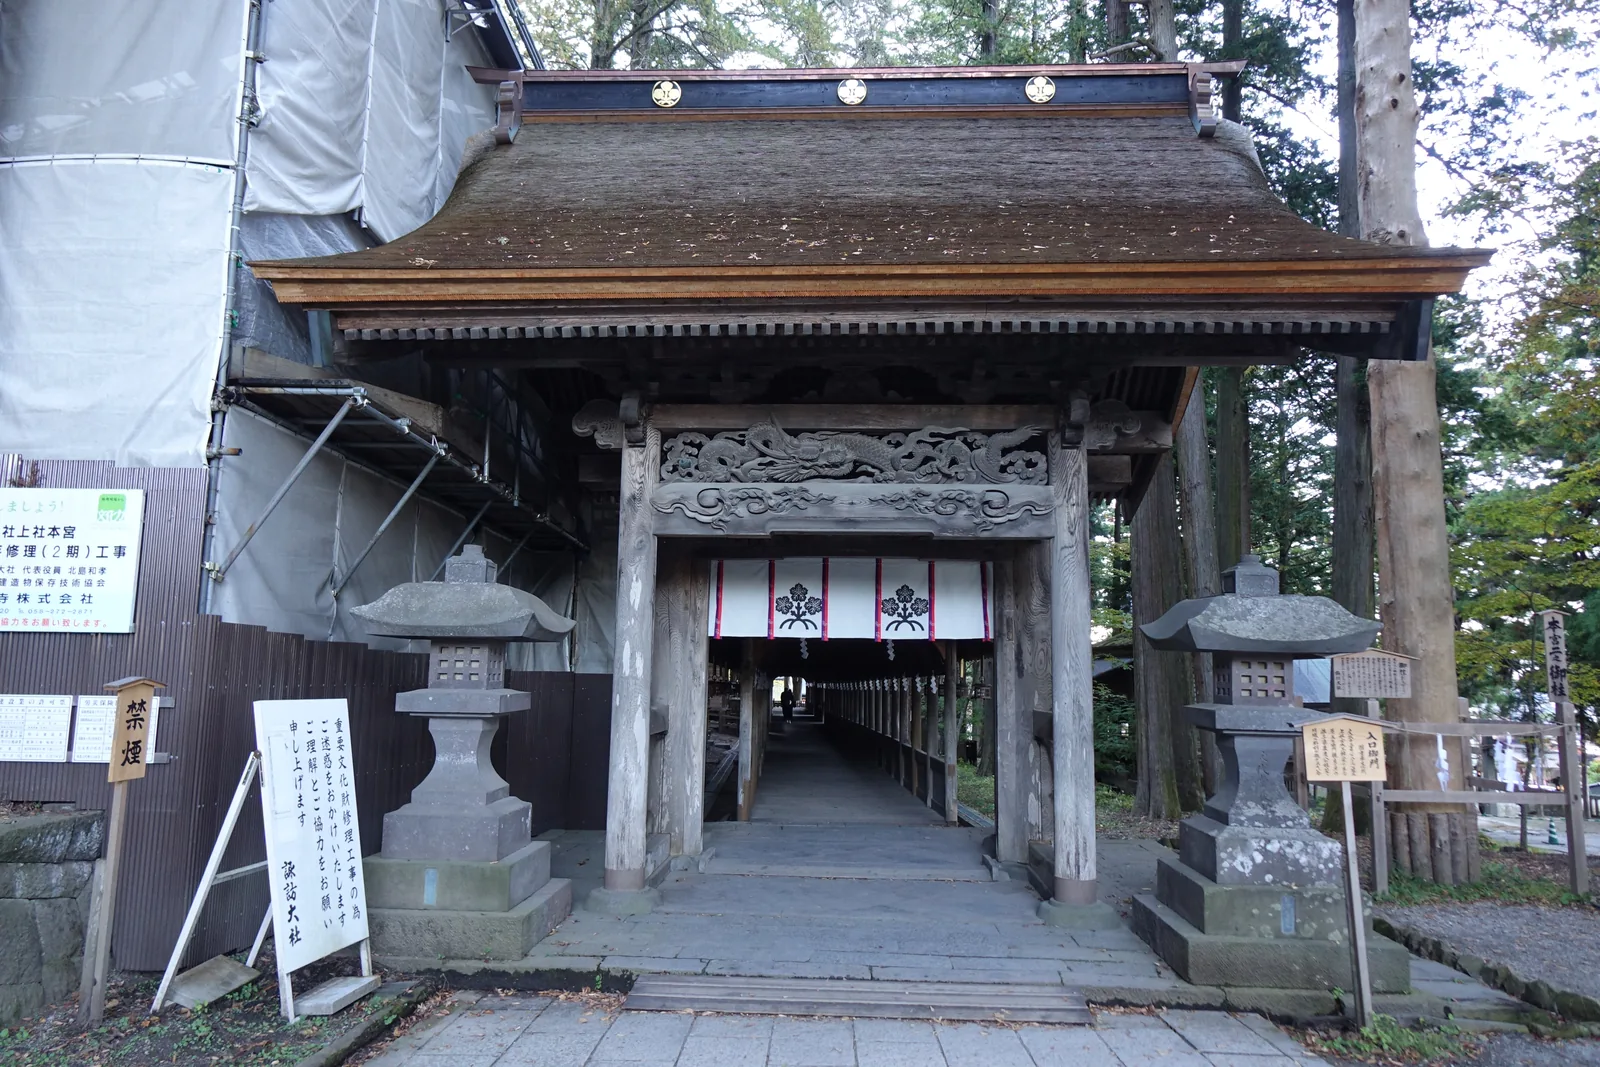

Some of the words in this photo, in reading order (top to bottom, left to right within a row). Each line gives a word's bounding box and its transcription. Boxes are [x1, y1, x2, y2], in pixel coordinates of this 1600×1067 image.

[0, 500, 64, 513] ましょう!
[2, 525, 76, 539] 社上社本宮
[0, 545, 127, 559] 修理(2期)工事
[121, 699, 147, 766] 禁煙
[290, 720, 306, 827] 申し上げます
[306, 720, 332, 928] ご理解とご協力をお願い
[321, 720, 346, 927] ご迷惑をおかけいたします
[334, 718, 361, 919] 重要文化財修理工事の為
[281, 861, 302, 947] 諏訪大社
